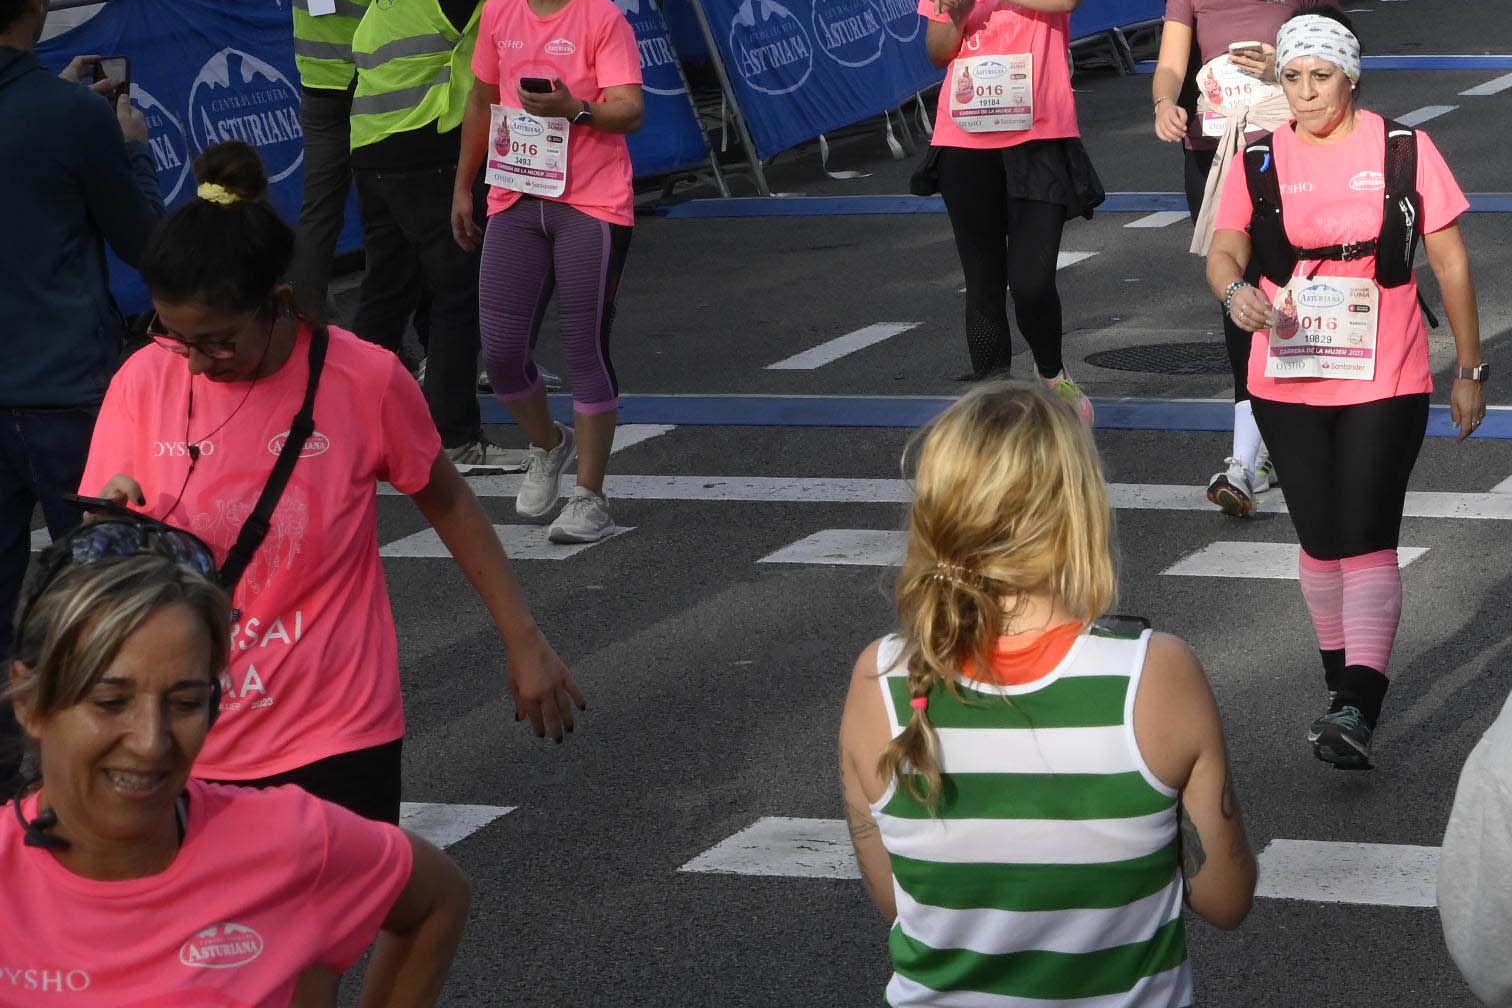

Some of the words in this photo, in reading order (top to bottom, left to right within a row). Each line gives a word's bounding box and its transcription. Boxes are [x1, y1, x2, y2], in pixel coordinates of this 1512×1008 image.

[976, 85, 1004, 97] 016
[1224, 83, 1252, 97] 016
[512, 141, 538, 156] 016
[514, 156, 531, 166] 3493
[1301, 316, 1338, 331] 016
[1304, 333, 1332, 344] 19829
[1279, 348, 1305, 356] CARRERA
[1324, 348, 1347, 356] MUJER
[1330, 361, 1366, 371] Santander
[188, 942, 258, 962] ASTURIANA
